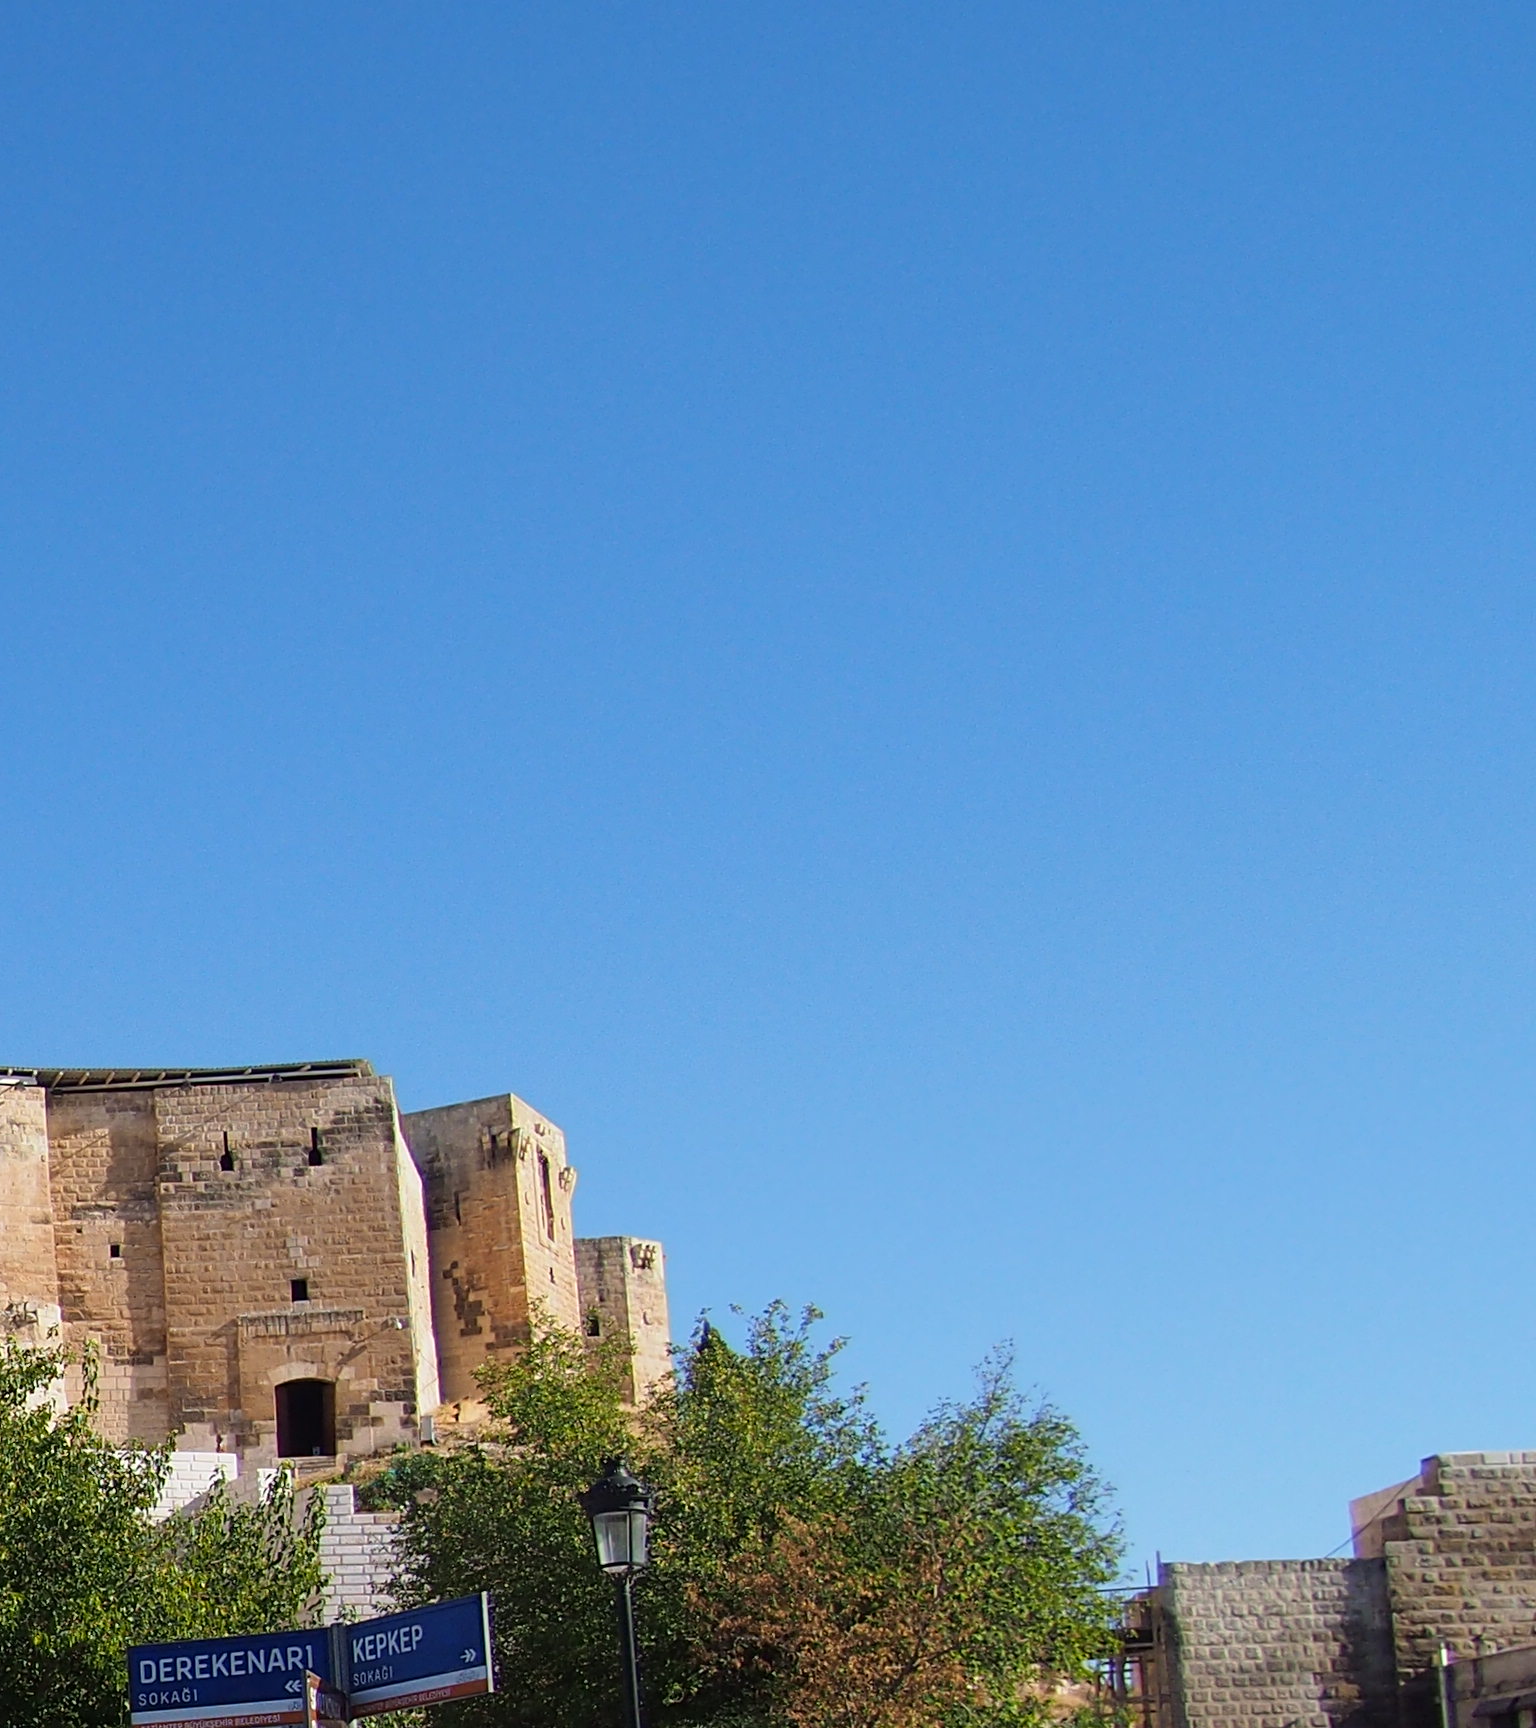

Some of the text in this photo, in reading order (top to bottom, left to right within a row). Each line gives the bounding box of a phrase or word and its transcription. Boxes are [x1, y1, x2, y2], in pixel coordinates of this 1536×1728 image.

[353, 1624, 423, 1663] KEPKEP
[139, 1645, 313, 1684] DEREKENARI
[353, 1666, 393, 1686] SOKAĞI
[138, 1687, 198, 1706] SOKAĞI
[234, 1714, 281, 1726] BELEDİYESİ
